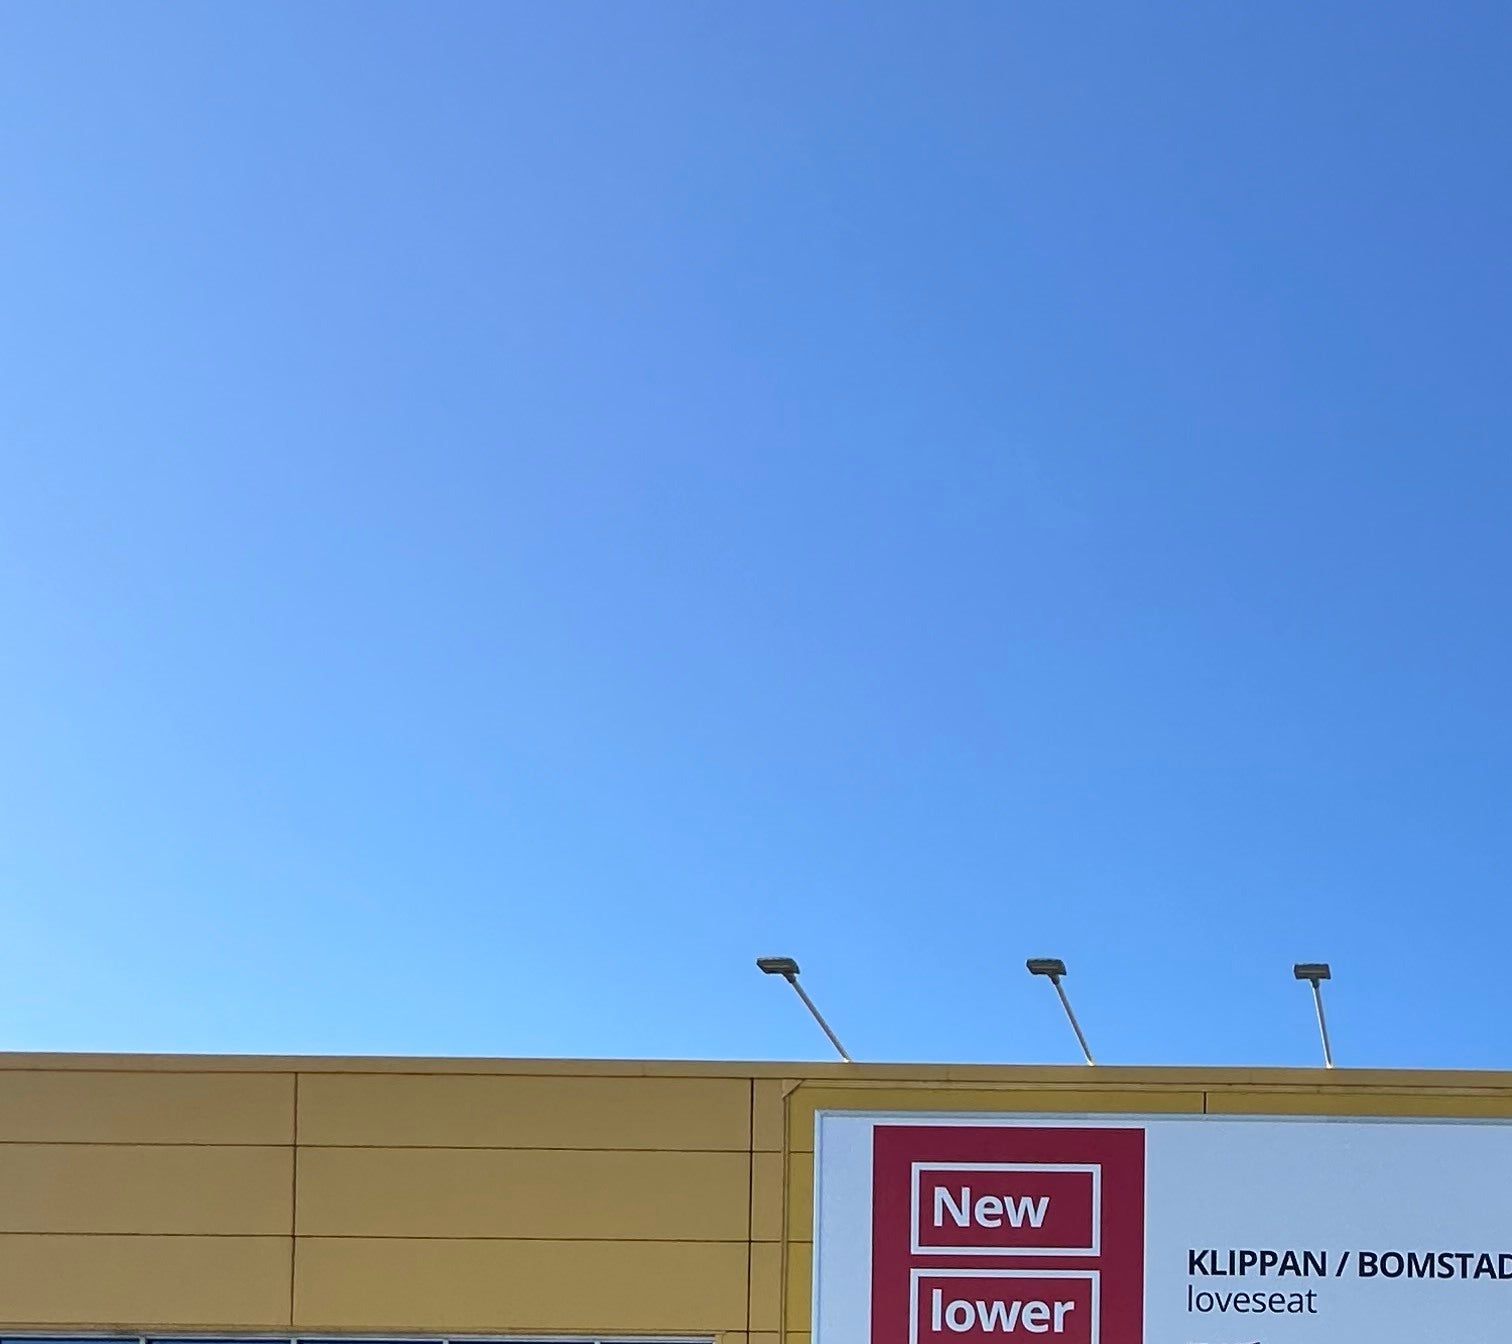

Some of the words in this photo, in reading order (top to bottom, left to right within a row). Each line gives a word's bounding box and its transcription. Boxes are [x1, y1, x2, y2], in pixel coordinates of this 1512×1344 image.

[933, 1186, 1050, 1228] New
[1188, 1249, 1327, 1277] KLIPPAN
[1335, 1251, 1351, 1277] /
[931, 1288, 1075, 1333] lower
[1188, 1284, 1318, 1314] loveseat
